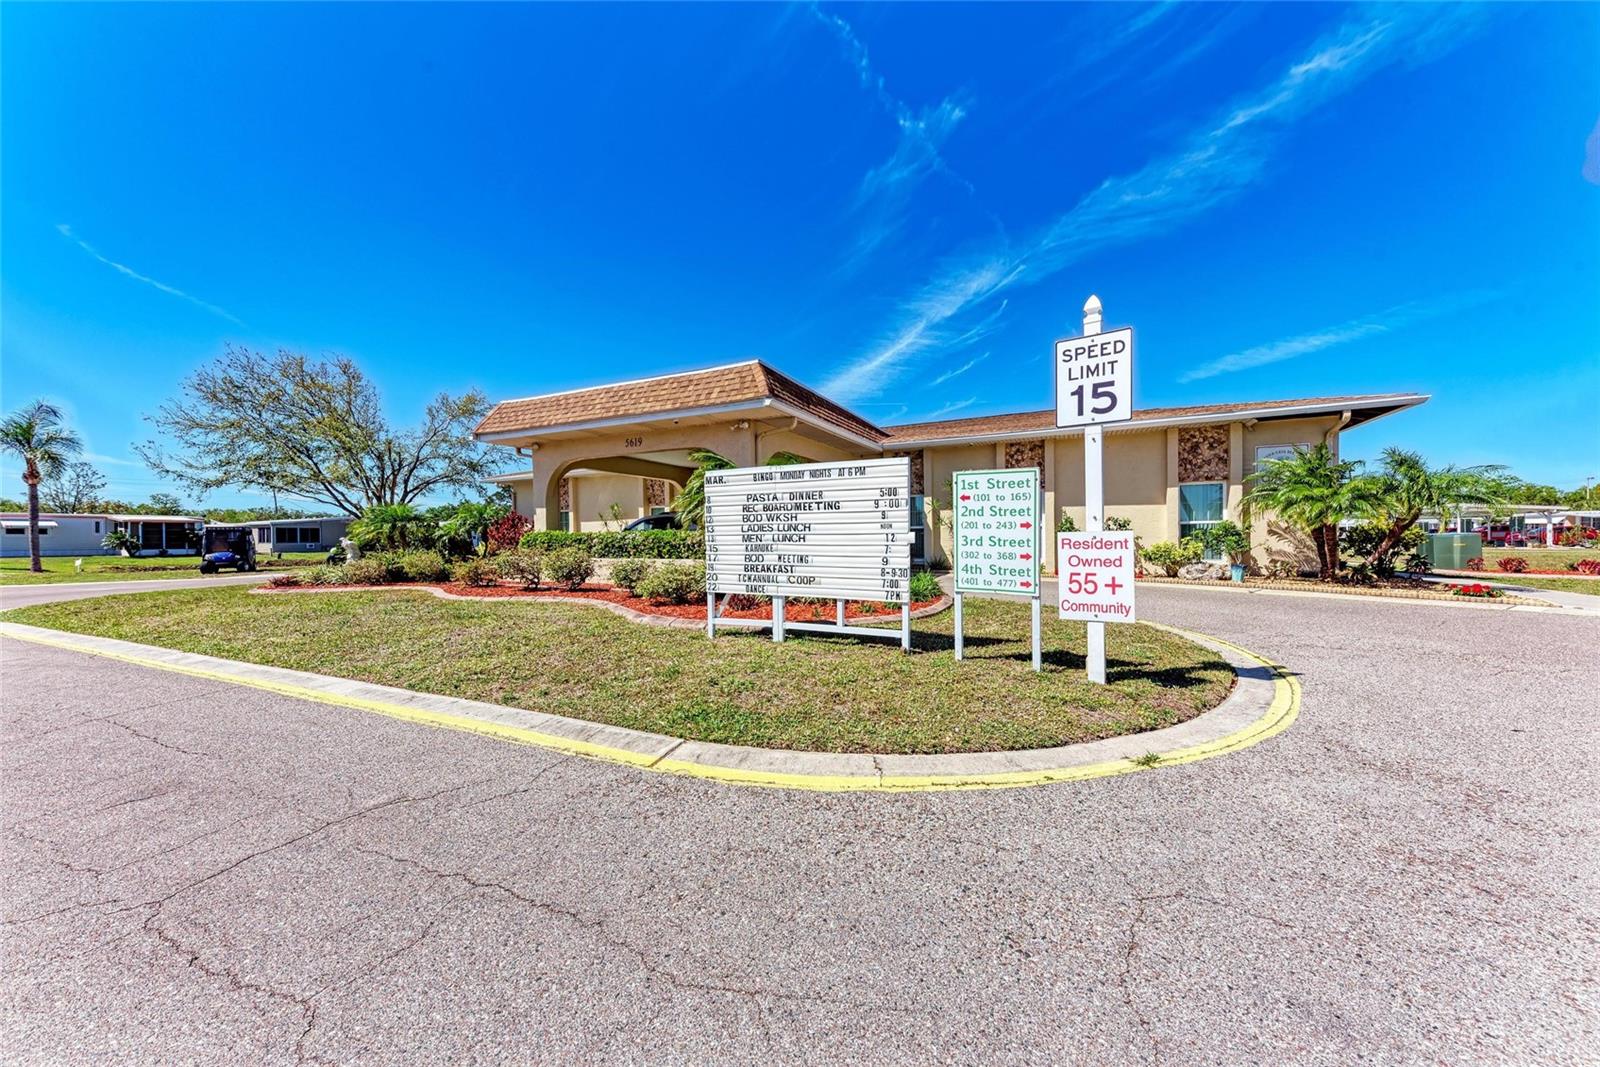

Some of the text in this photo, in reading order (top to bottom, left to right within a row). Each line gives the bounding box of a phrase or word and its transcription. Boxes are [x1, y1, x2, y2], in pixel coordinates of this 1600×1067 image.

[1062, 340, 1126, 363] SPEED
[1068, 360, 1118, 381] LIMIT
[1070, 380, 1118, 417] 15
[625, 437, 643, 448] 5619
[705, 466, 866, 485] MAR. BINGO MONDAY NIGHTS AT 6 PM
[961, 478, 1031, 490] 1st Street
[746, 493, 779, 502] PASTA
[788, 490, 824, 501] DINNER
[879, 487, 898, 497] 5:00
[973, 493, 990, 502] (101
[1010, 492, 1032, 501] 165)
[742, 503, 758, 512] REC
[961, 505, 1032, 517] 2nd Street
[742, 514, 763, 523] BOD
[766, 513, 798, 522] WKSH
[741, 524, 774, 533] LADIES
[777, 523, 811, 532] LUNCH
[961, 521, 1017, 530] (201 to 243)
[772, 533, 806, 543] LUNCH
[885, 533, 896, 542] 12
[961, 535, 1032, 548] 3rd Street
[1061, 538, 1129, 550] Resident
[709, 544, 718, 553] 15
[708, 553, 889, 566] 17 BOD MEETING 9
[961, 551, 979, 559] (302
[997, 551, 1017, 560] 368)
[1068, 555, 1123, 567] Owned
[743, 563, 795, 574] BREAKFAST
[961, 564, 1032, 577] 4th Street
[706, 573, 719, 582] 20
[787, 575, 816, 585] COOP
[881, 578, 899, 589] 7:00
[961, 577, 1017, 588] (401 to 477)
[708, 583, 717, 592] 22
[745, 584, 766, 594] DANCE
[1061, 599, 1132, 617] Community
